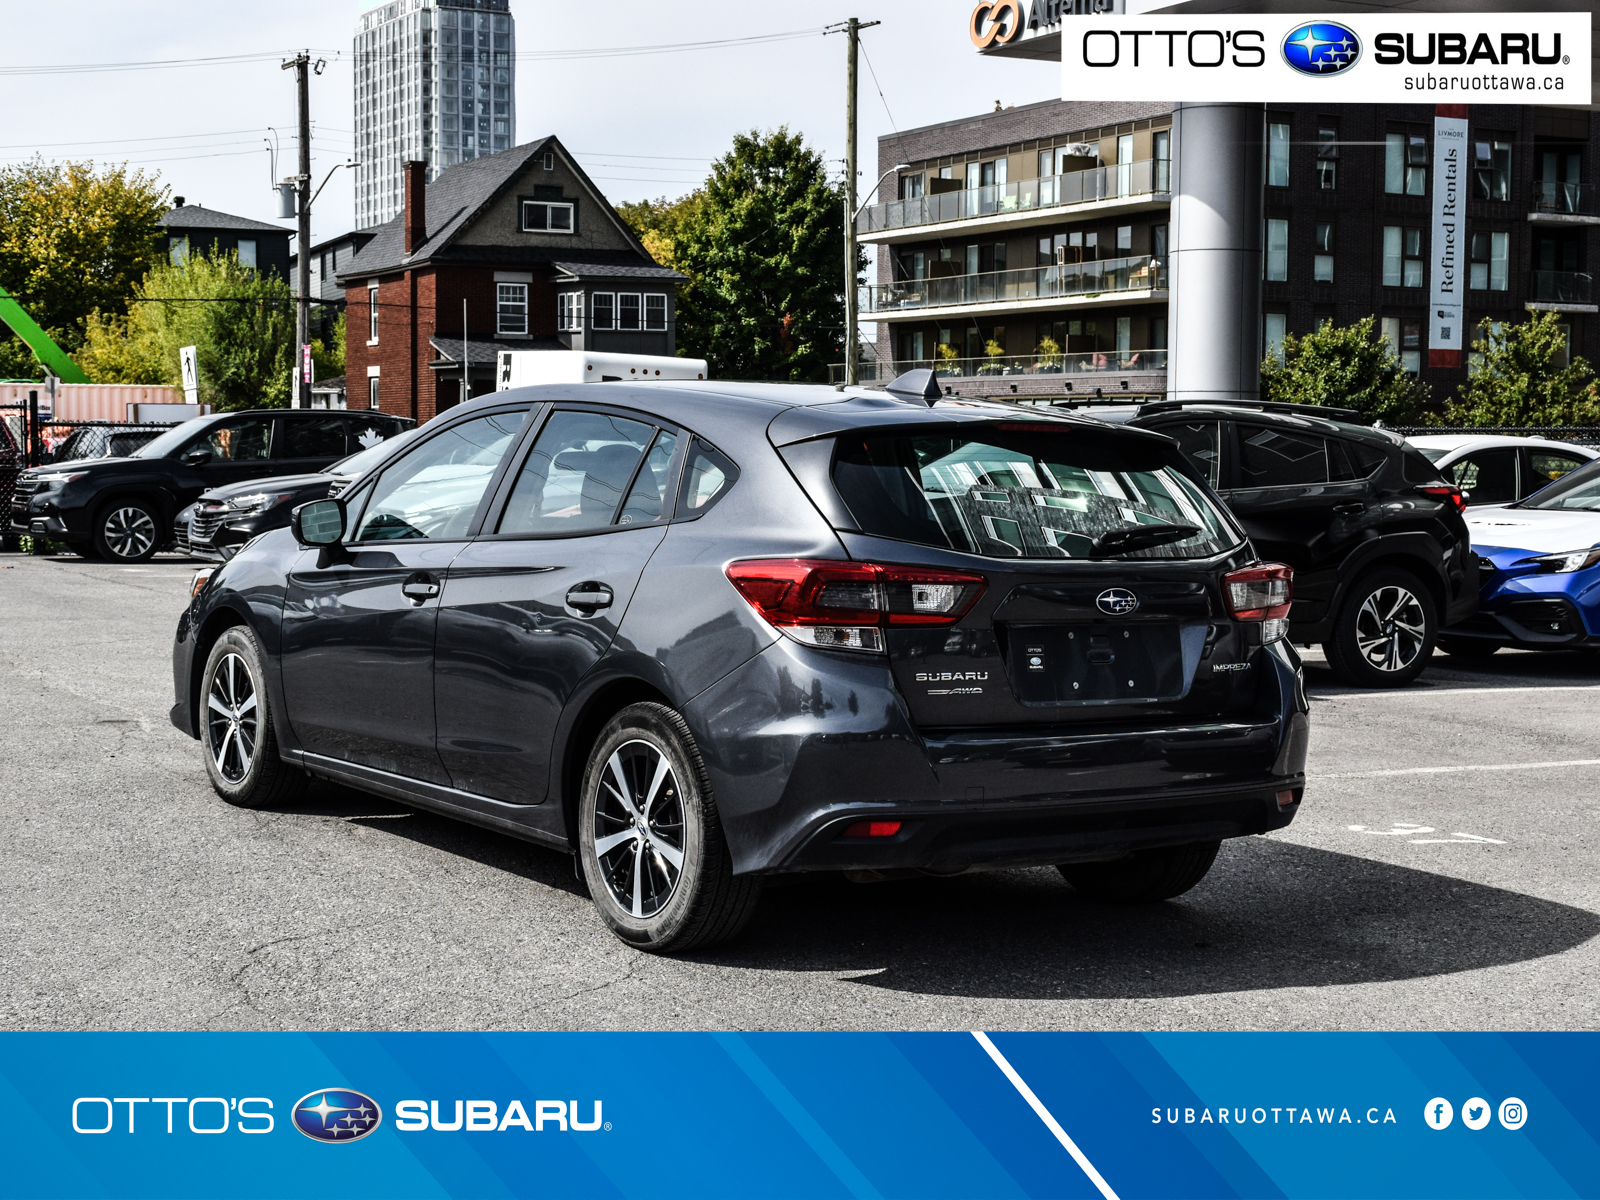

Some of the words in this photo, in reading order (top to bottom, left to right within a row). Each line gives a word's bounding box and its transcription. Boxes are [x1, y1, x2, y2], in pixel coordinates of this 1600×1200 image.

[1443, 148, 1457, 218] Rentals
[1441, 223, 1455, 294] Refined
[916, 672, 988, 681] SUBARU
[1212, 663, 1252, 672] IMPREZA
